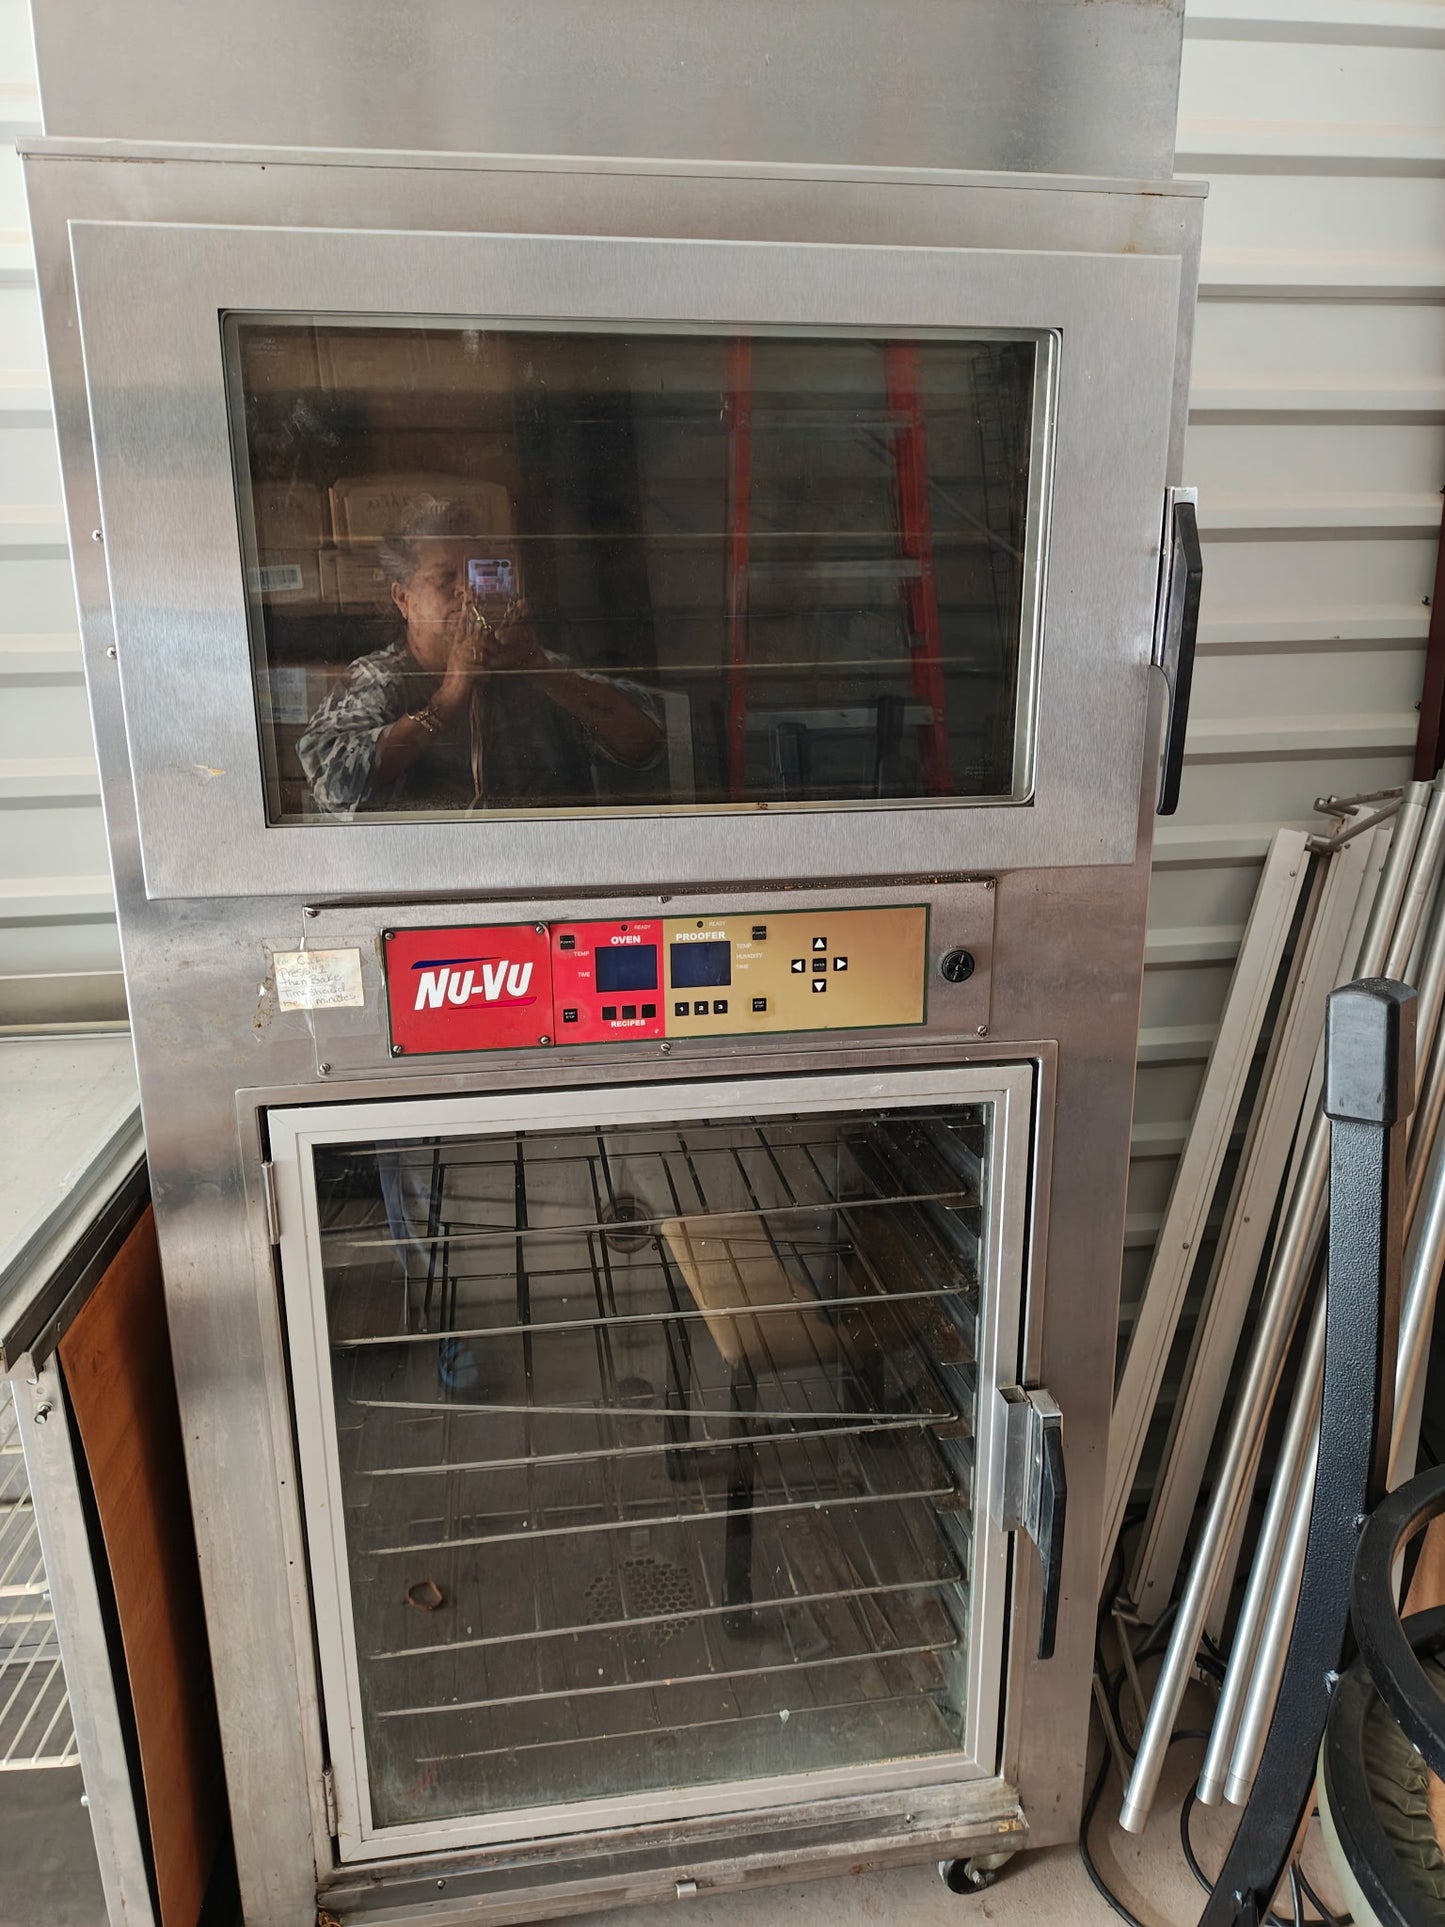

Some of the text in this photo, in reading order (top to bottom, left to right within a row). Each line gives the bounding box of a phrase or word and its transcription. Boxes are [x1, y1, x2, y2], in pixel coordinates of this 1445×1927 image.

[611, 935, 641, 944] OVEN
[675, 931, 726, 941] PROOFER
[309, 973, 342, 985] Bake
[611, 1020, 646, 1028] RECIPES
